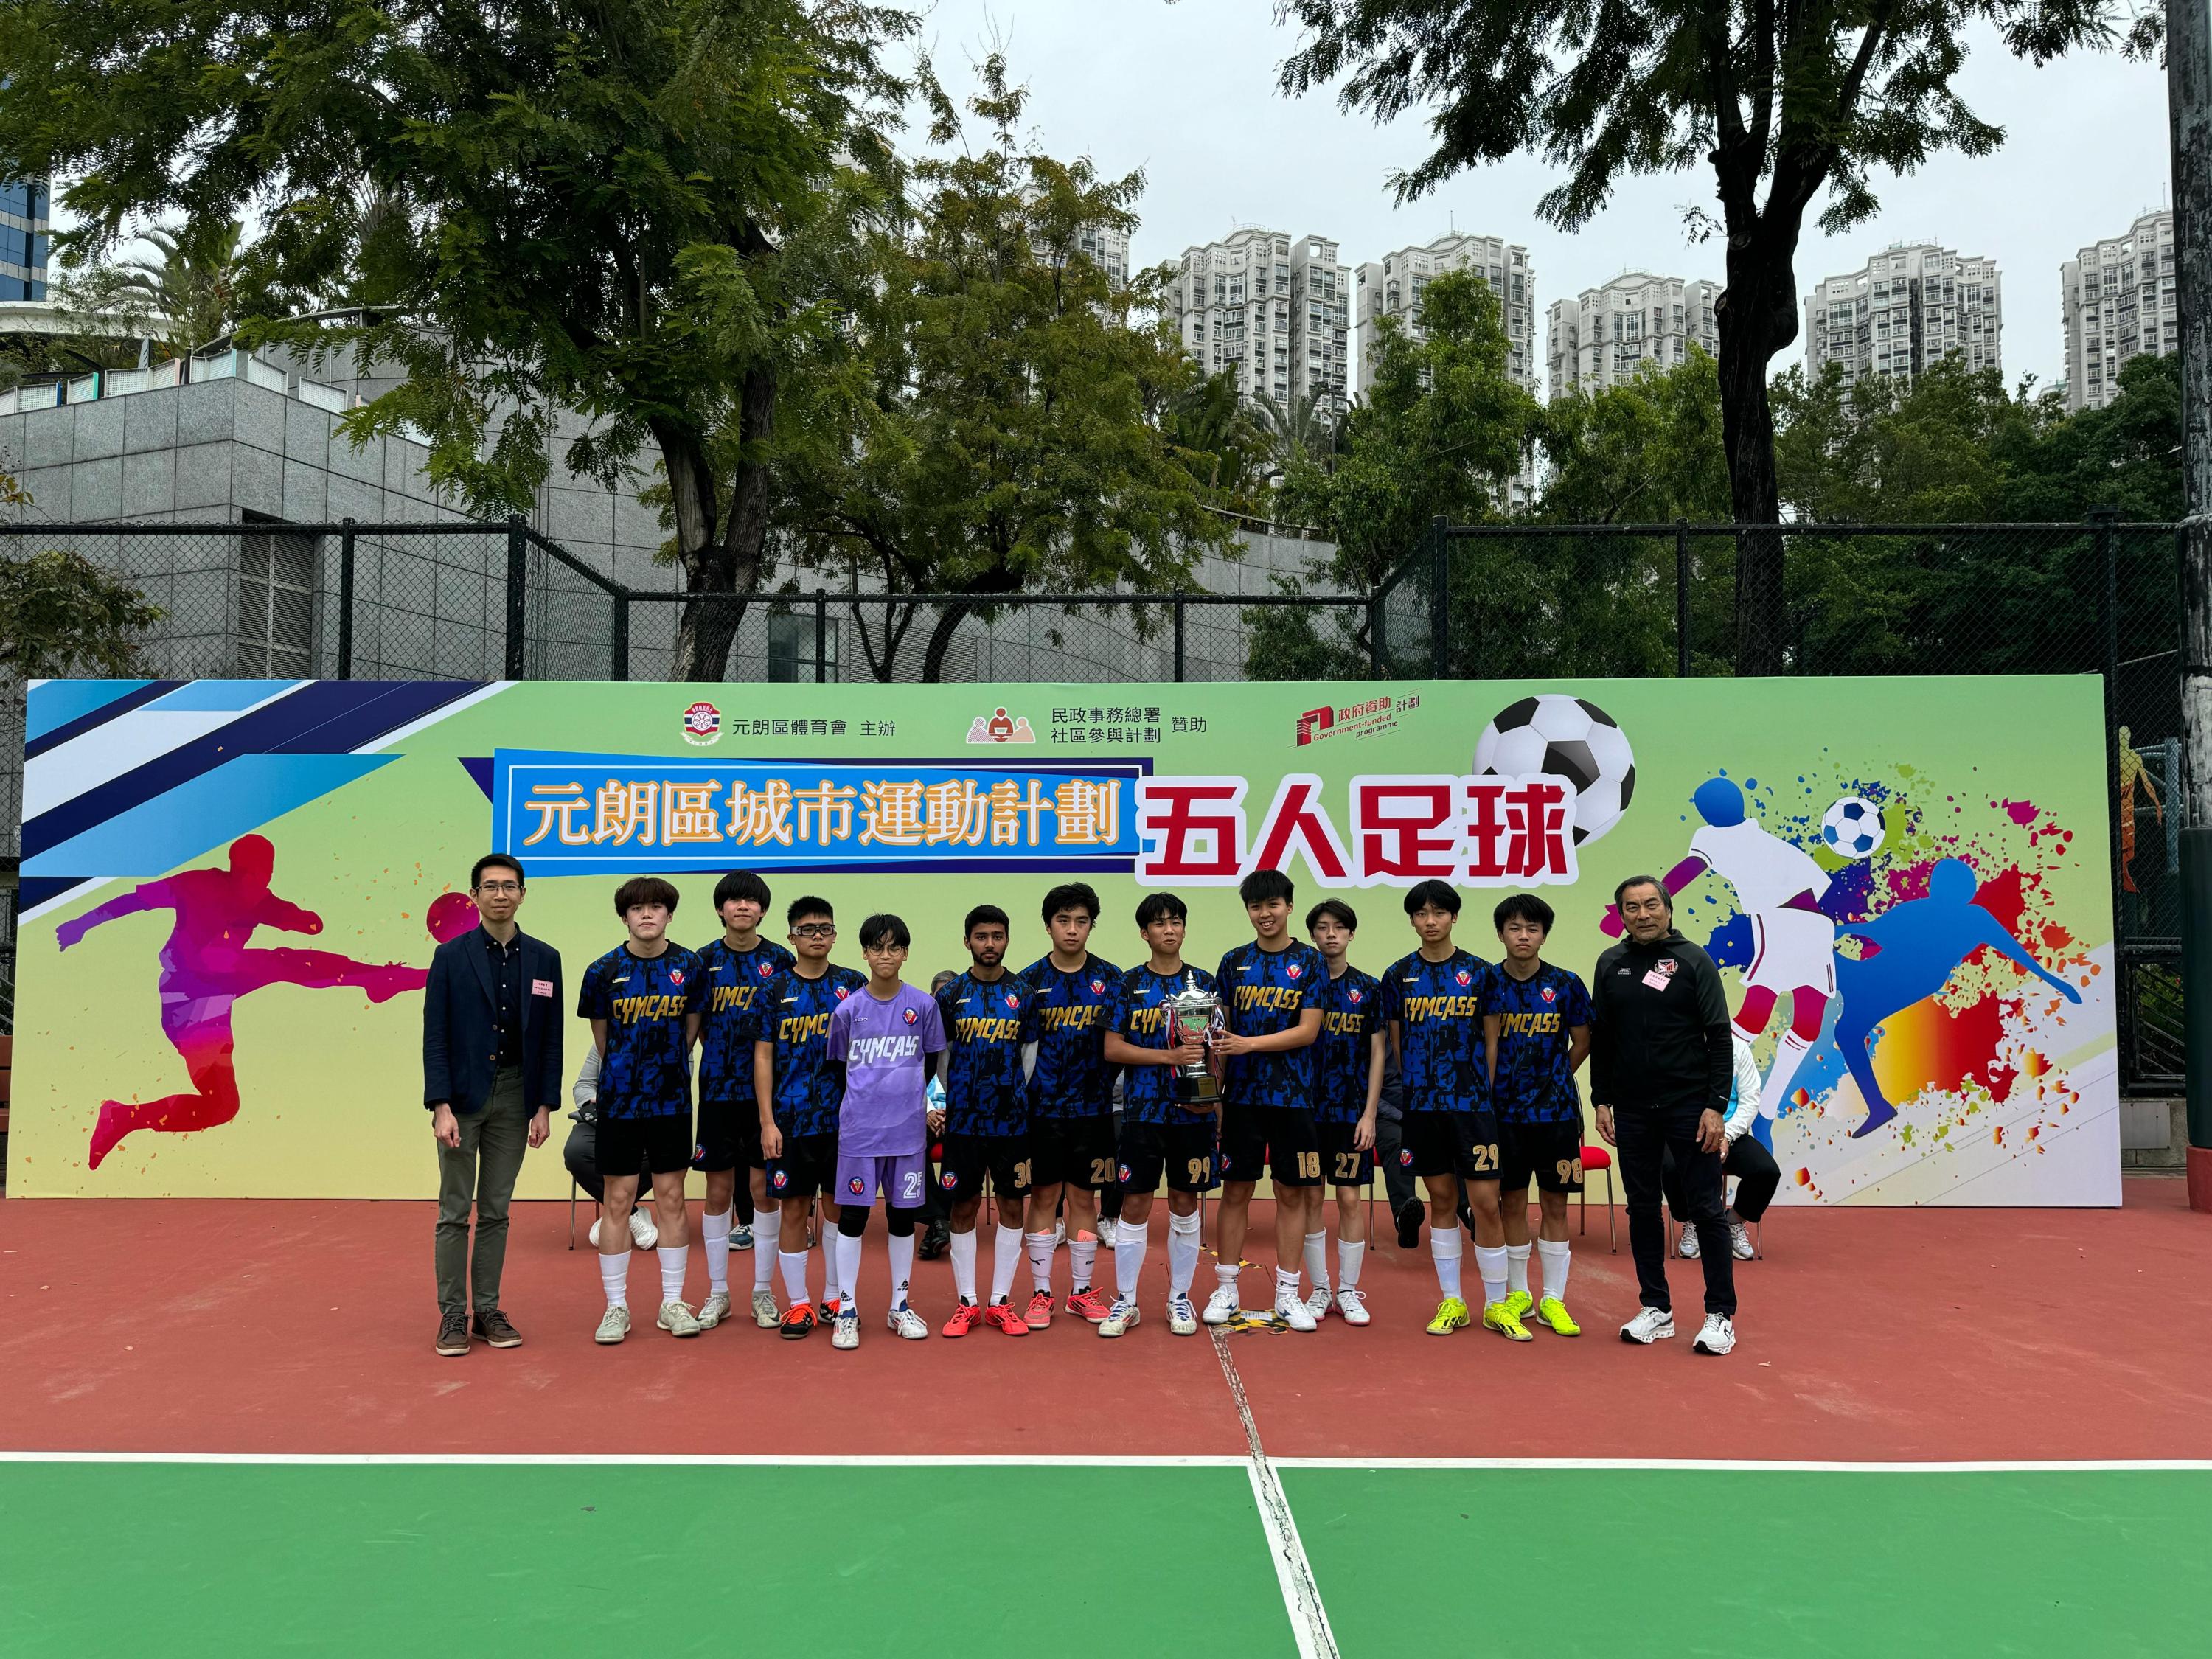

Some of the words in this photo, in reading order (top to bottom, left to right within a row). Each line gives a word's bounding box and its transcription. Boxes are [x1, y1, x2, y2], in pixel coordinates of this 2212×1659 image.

[1051, 706, 1161, 724] 民政事務總署
[1338, 696, 1391, 723] 政府資助
[1395, 695, 1420, 714] 計劃
[731, 719, 848, 736] 元朗區體育會
[859, 720, 897, 737] 主辦
[1050, 727, 1161, 744] 社區參與計劃
[1171, 716, 1208, 734] 贊助
[1313, 712, 1391, 741] Government-funded
[1355, 720, 1399, 740] programme
[523, 778, 1121, 846] 元朗區城市運動計劃
[1143, 782, 1570, 879] 五人足球
[613, 995, 689, 1025] CYMCASS
[1234, 985, 1304, 1012] CYMCASS
[1404, 995, 1478, 1022] CYMCASS
[848, 1035, 920, 1064] CYMCASS
[1090, 1157, 1116, 1184] 20
[1188, 1155, 1211, 1184] 99
[1297, 1151, 1321, 1178] 18
[1335, 1152, 1361, 1178] 27
[1472, 1143, 1500, 1172] 29
[1556, 1158, 1584, 1184] 98
